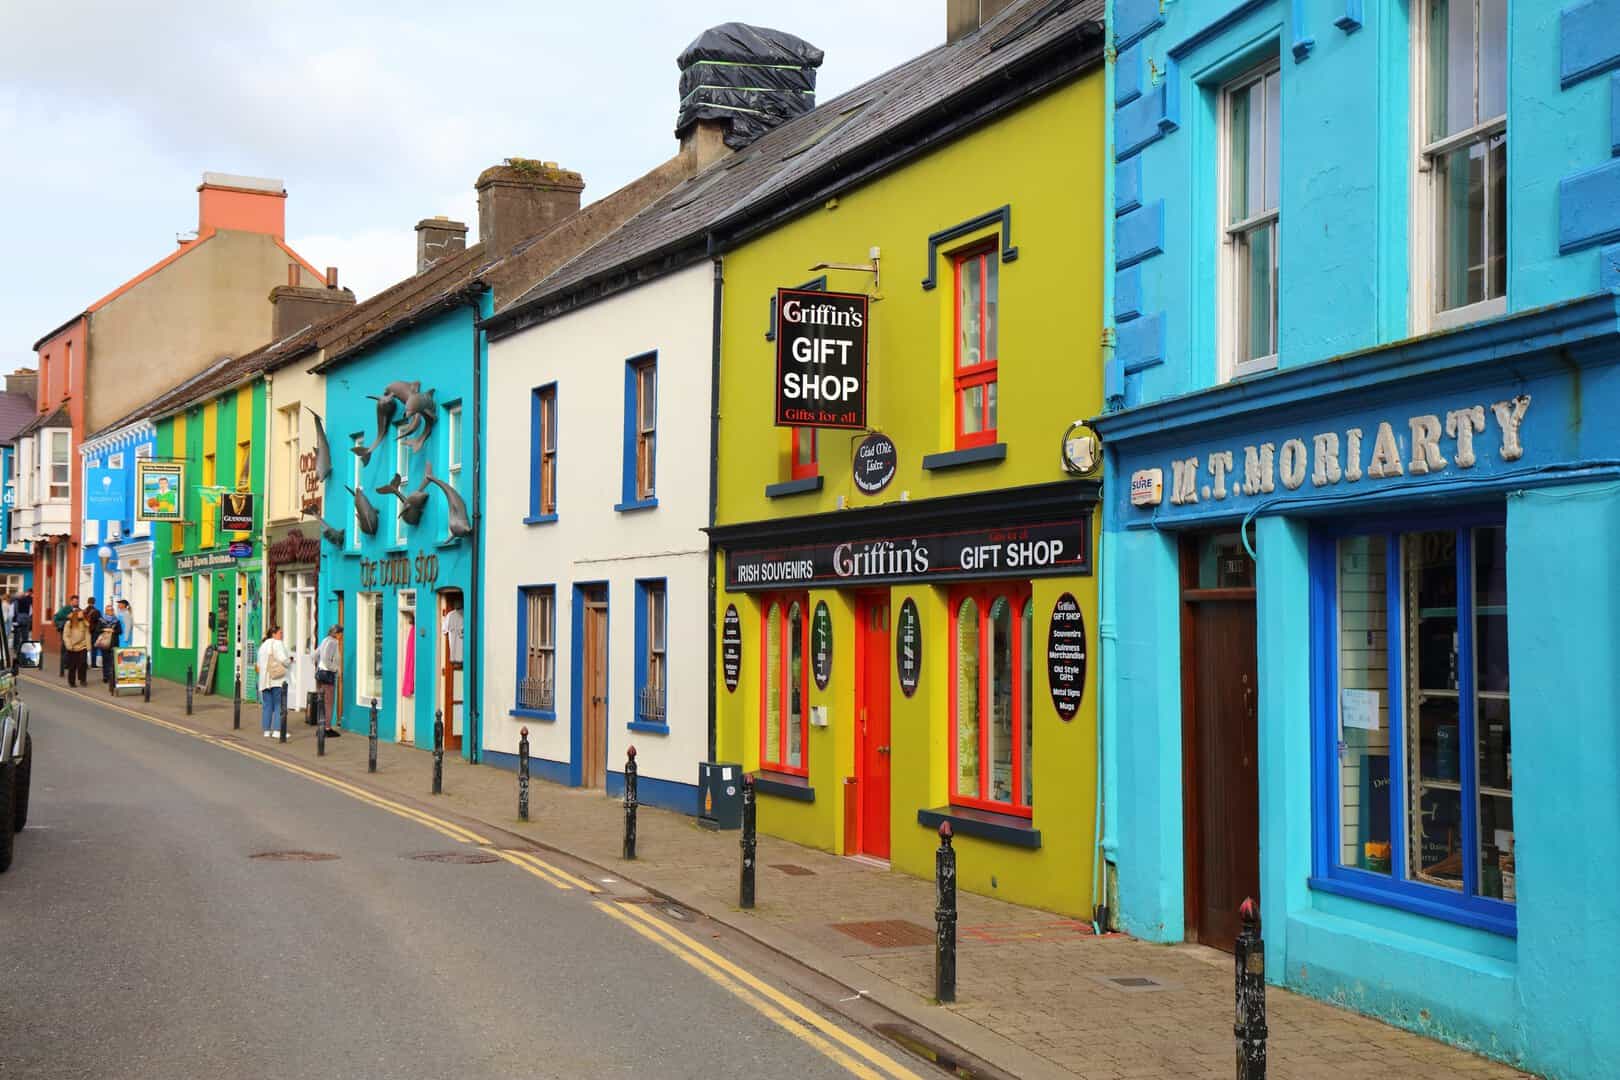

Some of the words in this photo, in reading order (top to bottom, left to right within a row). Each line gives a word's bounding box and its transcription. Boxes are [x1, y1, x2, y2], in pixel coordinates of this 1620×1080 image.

[783, 300, 863, 328] Griffin's
[792, 336, 853, 365] GIFT
[783, 372, 859, 401] SHOP
[785, 408, 815, 421] Gifts
[819, 410, 837, 422] for
[841, 411, 856, 423] all
[1132, 478, 1153, 490] SURE
[737, 564, 760, 582] IRISH
[761, 560, 814, 581] SOUVENIRS
[833, 538, 929, 577] Griffin's
[960, 544, 1002, 569] GIFT
[1006, 539, 1064, 567] SHOP
[1053, 612, 1065, 620] GIFT
[1066, 612, 1080, 620] SHOP
[1053, 630, 1081, 638] Souvenirs
[1049, 651, 1084, 659] Merchandise
[1053, 665, 1063, 673] Old
[1064, 665, 1079, 674] Style
[1059, 701, 1074, 710] Mugs
